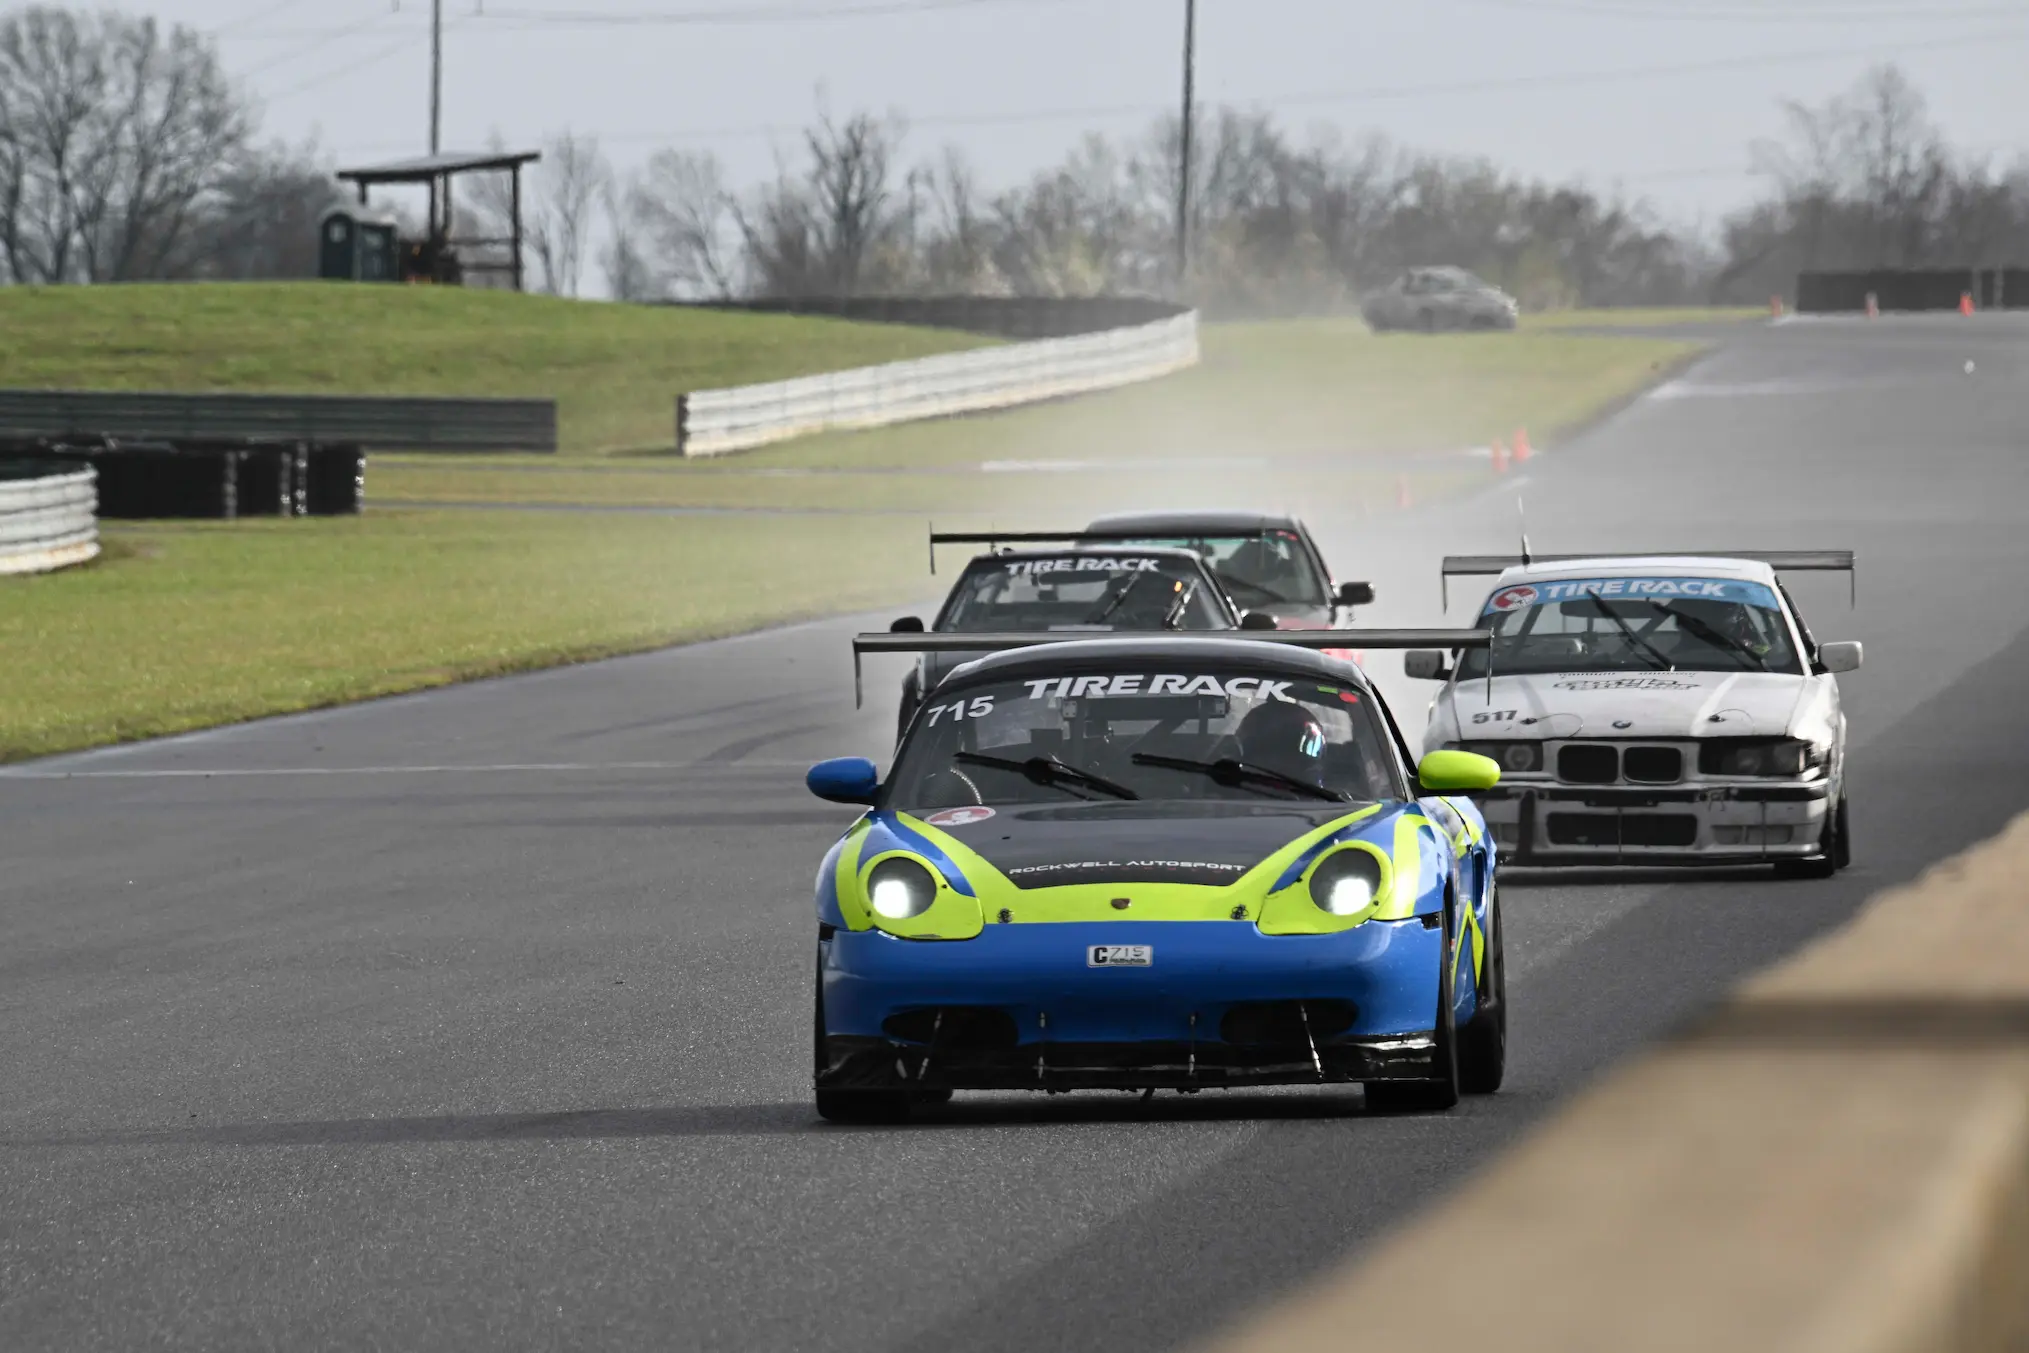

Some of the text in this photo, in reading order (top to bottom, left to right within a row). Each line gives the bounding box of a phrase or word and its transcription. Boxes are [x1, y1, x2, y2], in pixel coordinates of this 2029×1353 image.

[1005, 558, 1160, 575] TIRE RACK
[1544, 580, 1727, 598] TIRE RACK
[1024, 674, 1294, 701] TIRE RACK
[927, 695, 995, 727] 715
[1471, 710, 1518, 724] 517
[1009, 860, 1121, 875] ROCKWELL
[1126, 860, 1246, 872] AUTOSPORT
[1094, 947, 1108, 964] C
